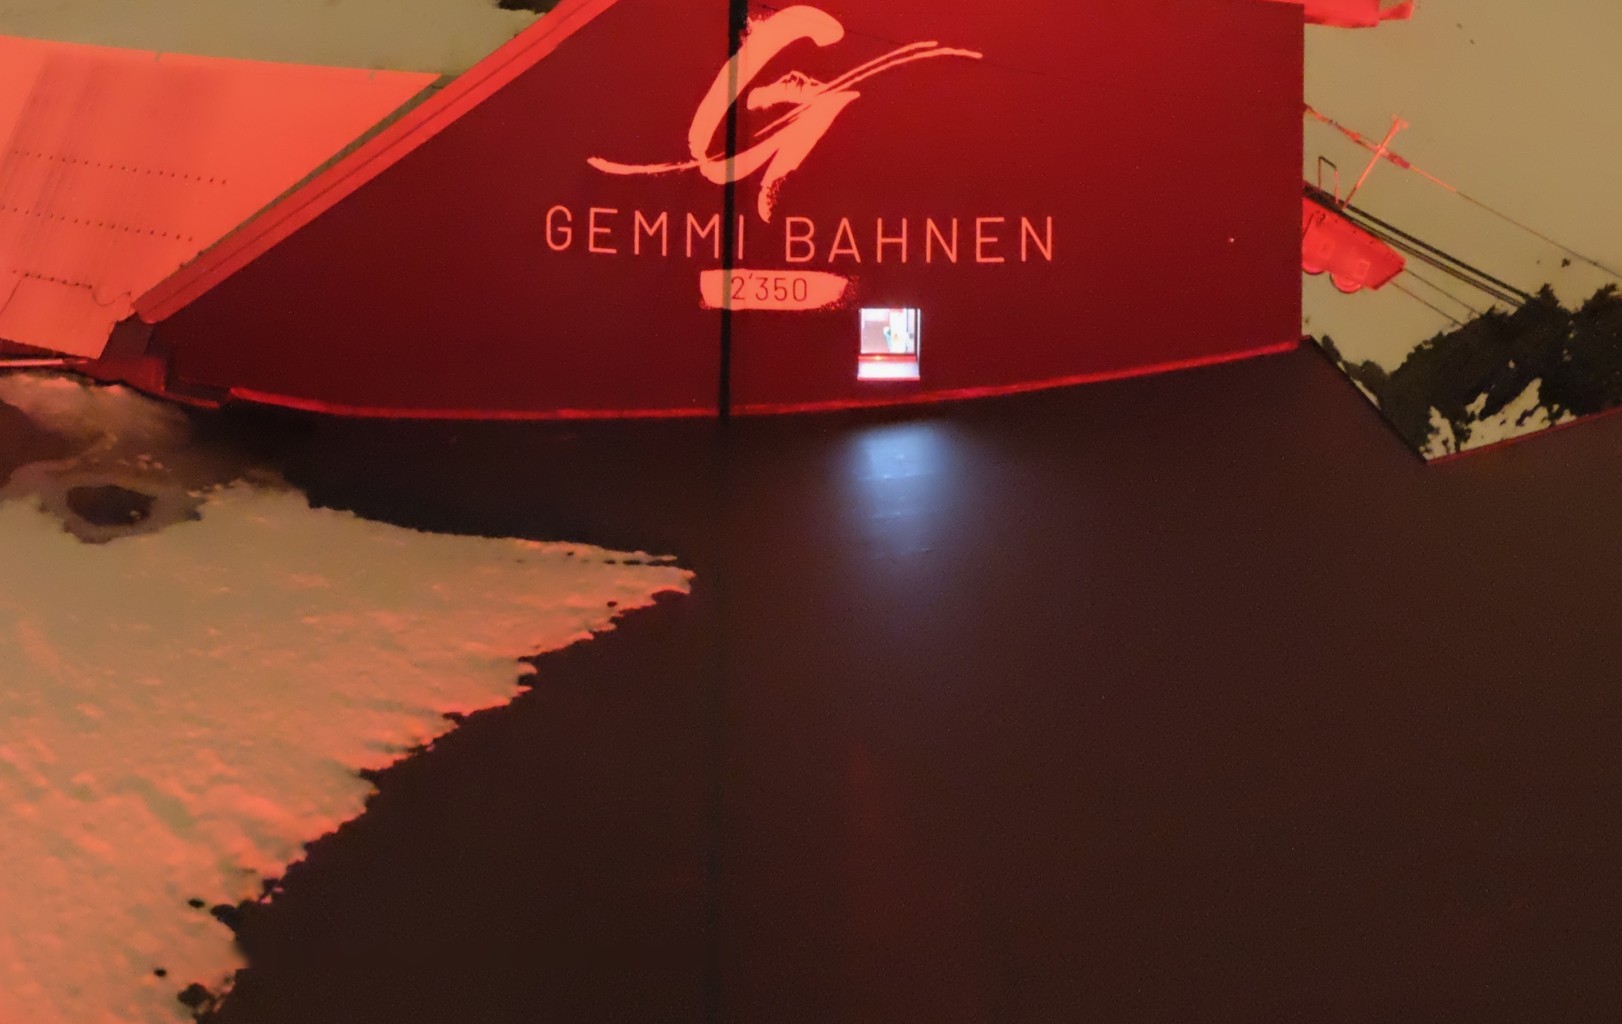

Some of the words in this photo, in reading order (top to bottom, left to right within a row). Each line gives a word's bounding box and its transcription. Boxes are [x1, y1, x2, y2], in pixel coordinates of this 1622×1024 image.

[545, 205, 744, 260] GEMMI
[785, 216, 1053, 264] BAHNEN
[730, 273, 809, 303] 2'350
